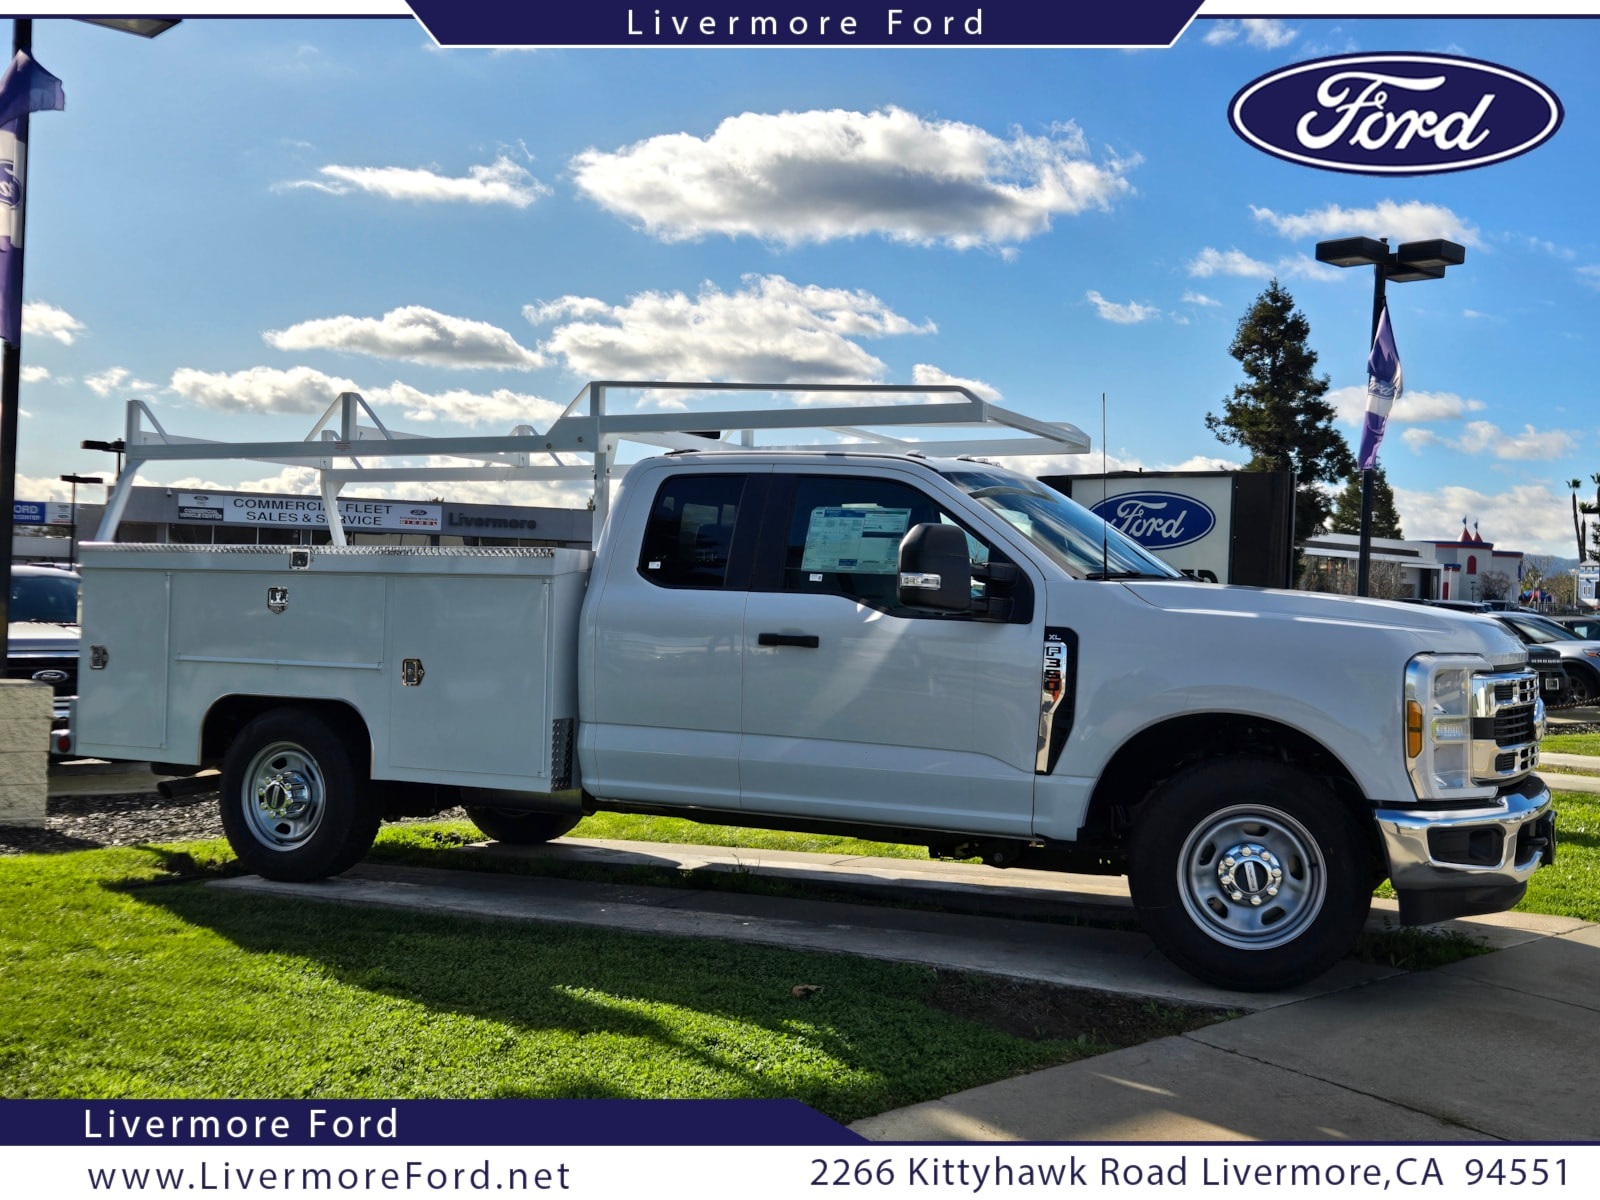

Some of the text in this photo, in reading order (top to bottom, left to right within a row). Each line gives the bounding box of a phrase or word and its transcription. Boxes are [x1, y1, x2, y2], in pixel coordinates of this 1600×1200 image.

[233, 498, 393, 515] COMMERCI FLEET
[246, 511, 382, 526] SALES & SRVICE
[448, 512, 537, 530] Livermore
[1111, 499, 1188, 539] Ford
